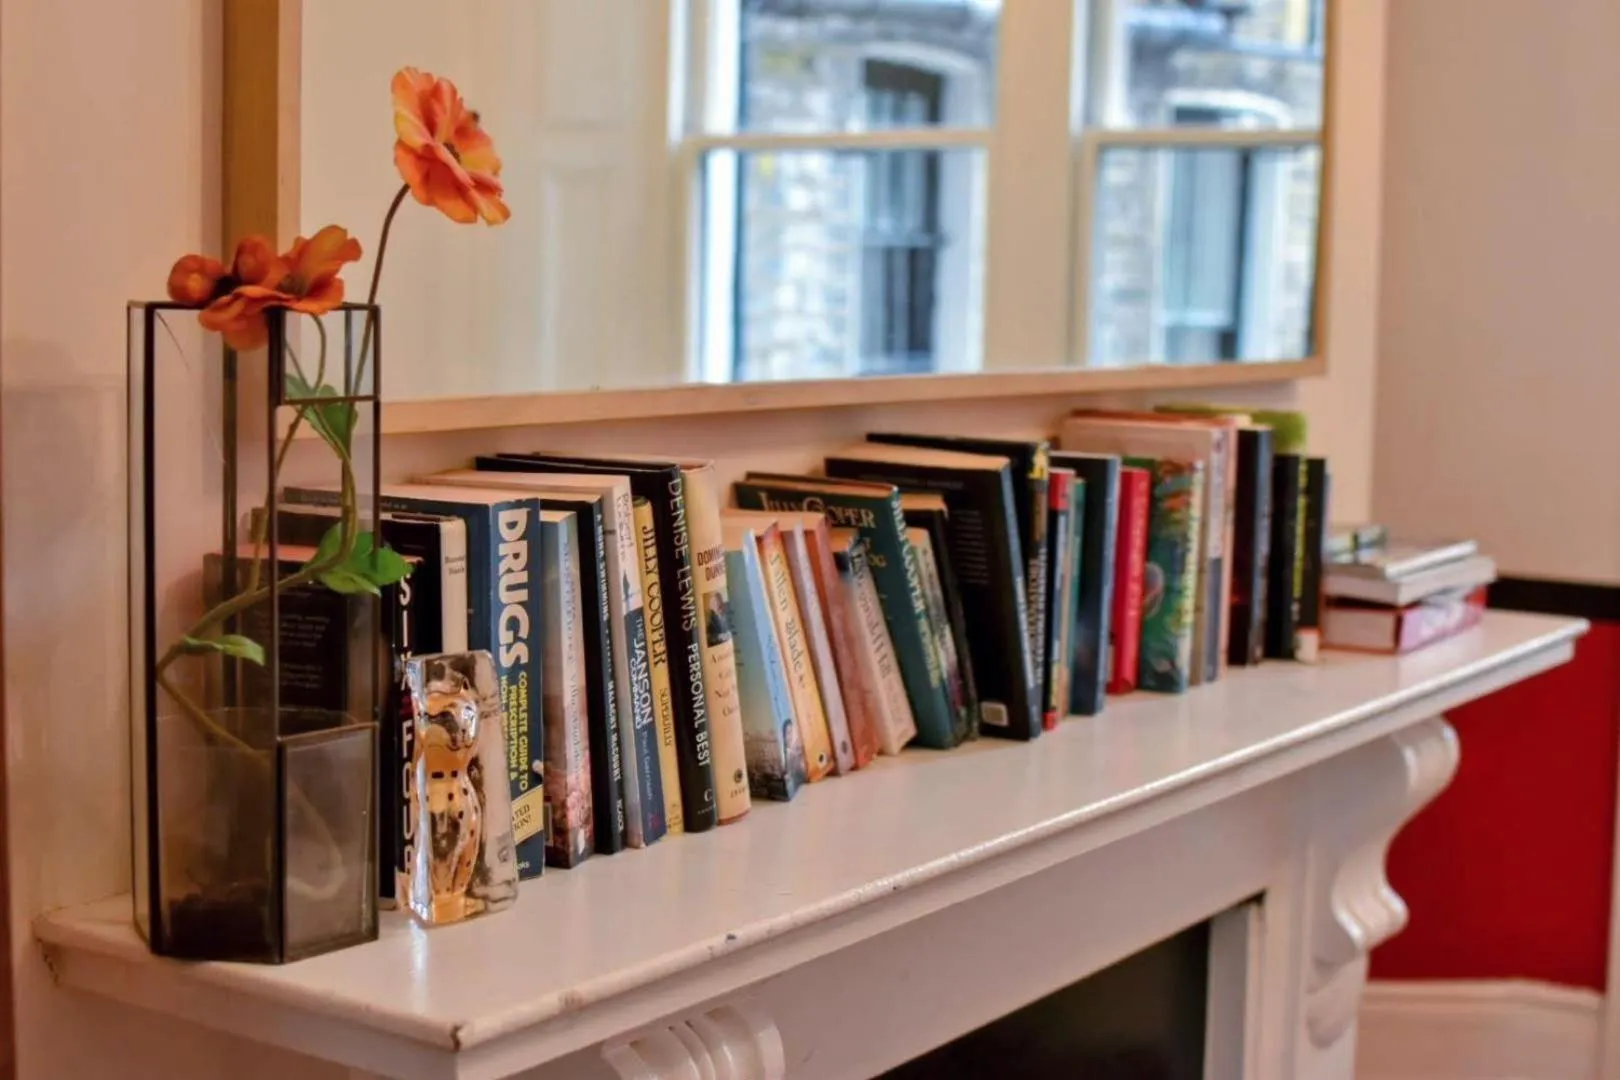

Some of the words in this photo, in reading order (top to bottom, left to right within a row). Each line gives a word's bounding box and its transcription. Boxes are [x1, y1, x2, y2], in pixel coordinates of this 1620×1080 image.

[642, 525, 658, 576] JILLY
[668, 478, 687, 560] DENISE
[498, 508, 530, 669] DRUGS
[647, 581, 666, 668] COOPER
[677, 564, 698, 632] LEWIS
[518, 671, 528, 733] COMPLETE
[630, 657, 643, 730] COMMAND
[633, 638, 653, 725] JANSON
[687, 643, 706, 729] PERSONAL
[508, 685, 518, 769] PRESCRIPTION
[519, 736, 528, 771] GUIDE
[696, 730, 711, 767] BEST
[519, 773, 528, 791] TO
